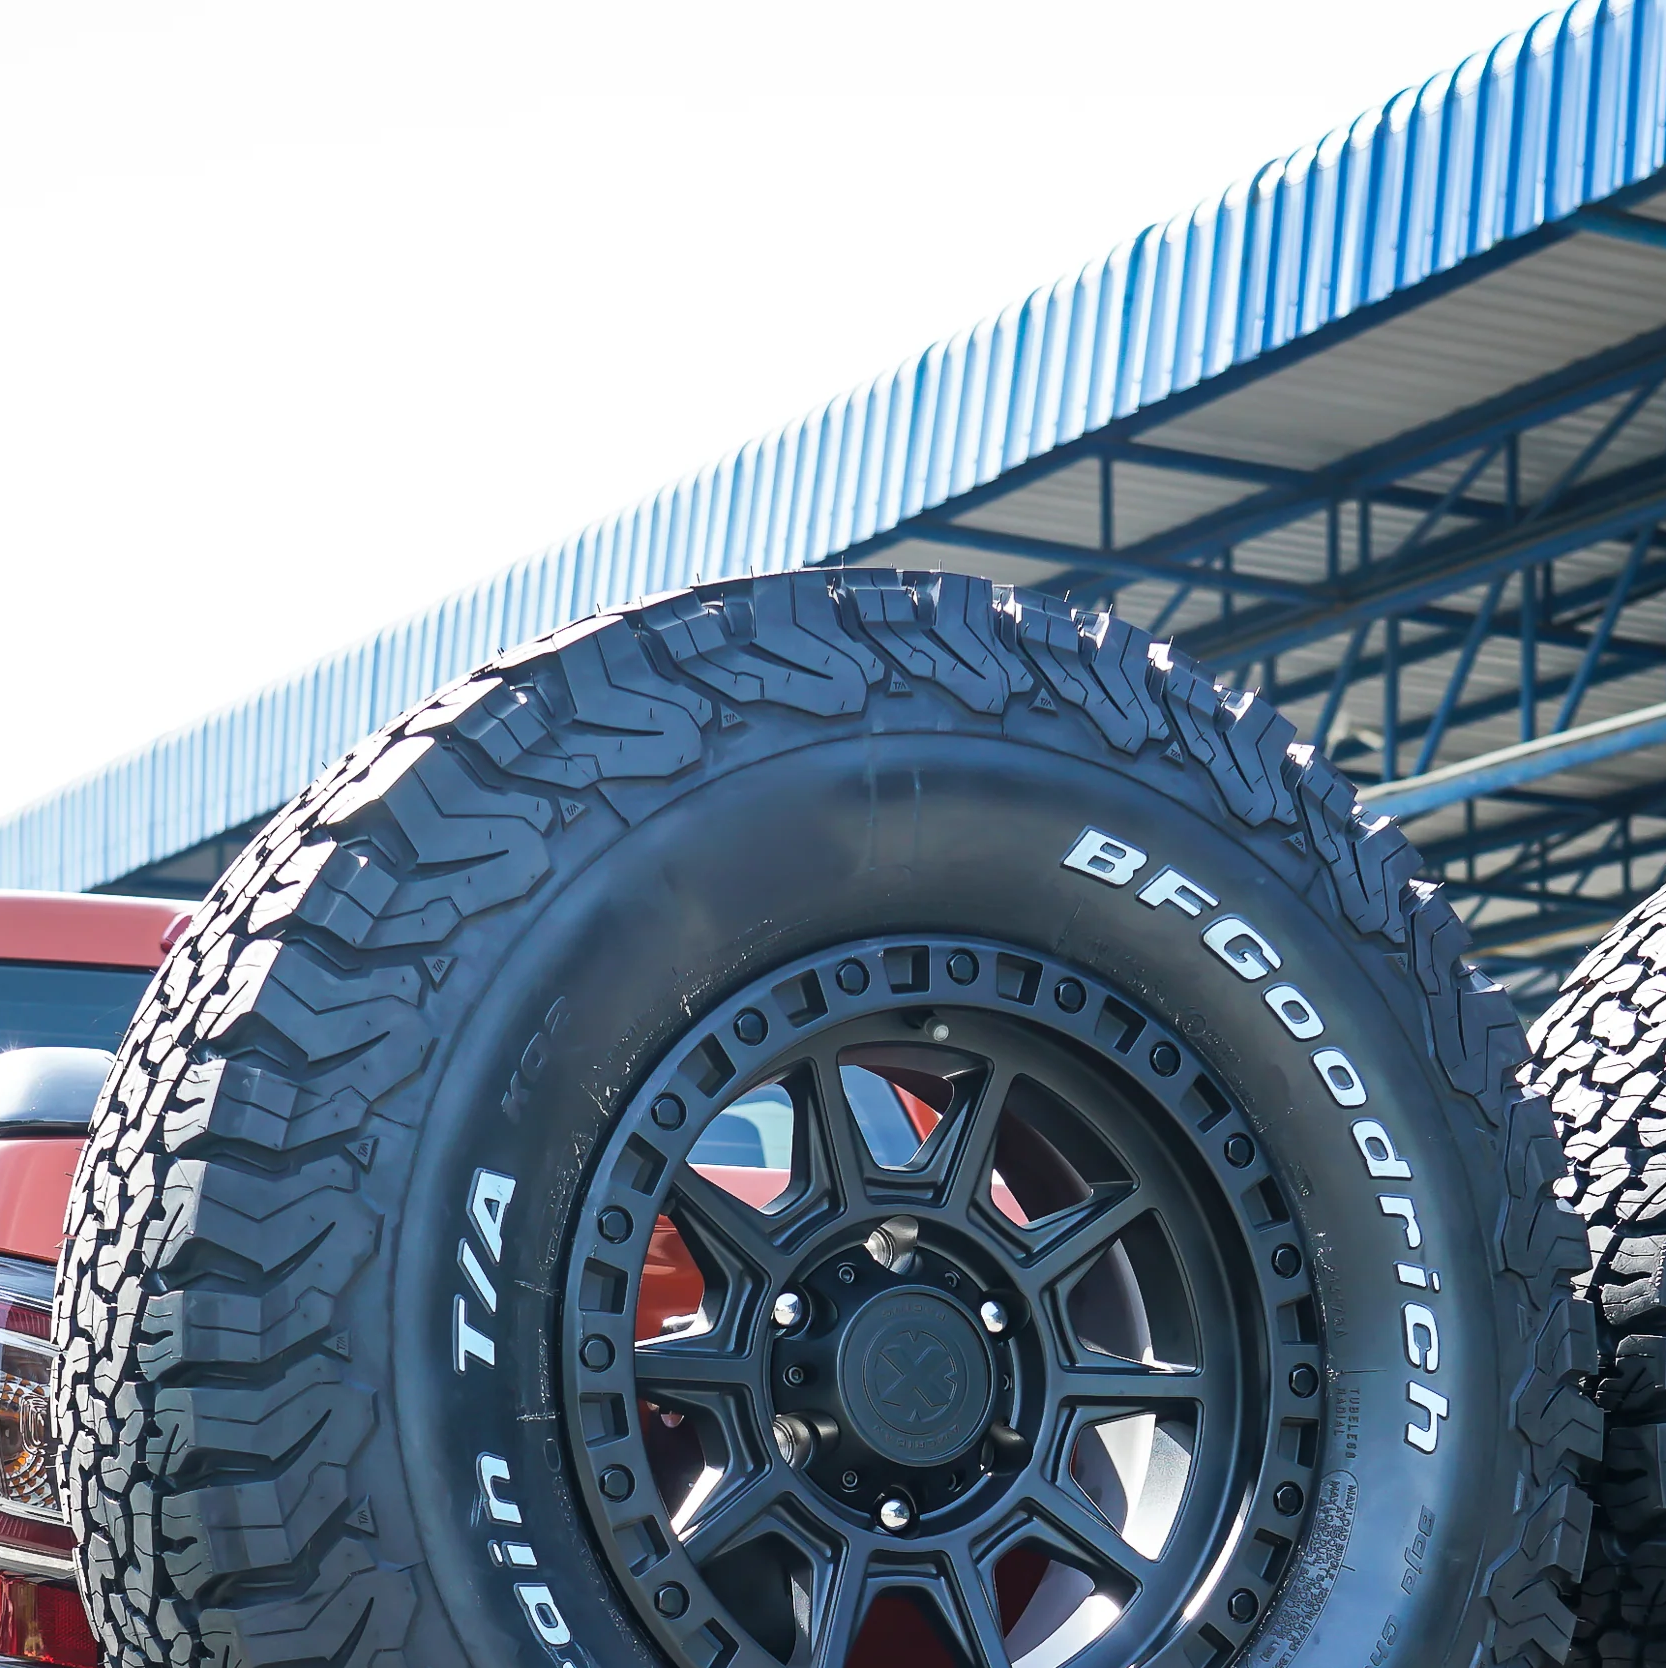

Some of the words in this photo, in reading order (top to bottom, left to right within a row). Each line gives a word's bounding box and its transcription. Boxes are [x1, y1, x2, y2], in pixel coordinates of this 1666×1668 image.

[1061, 826, 1458, 1458] BFGoodrich
[452, 1166, 518, 1374] T/A
[1401, 1504, 1436, 1595] Baja
